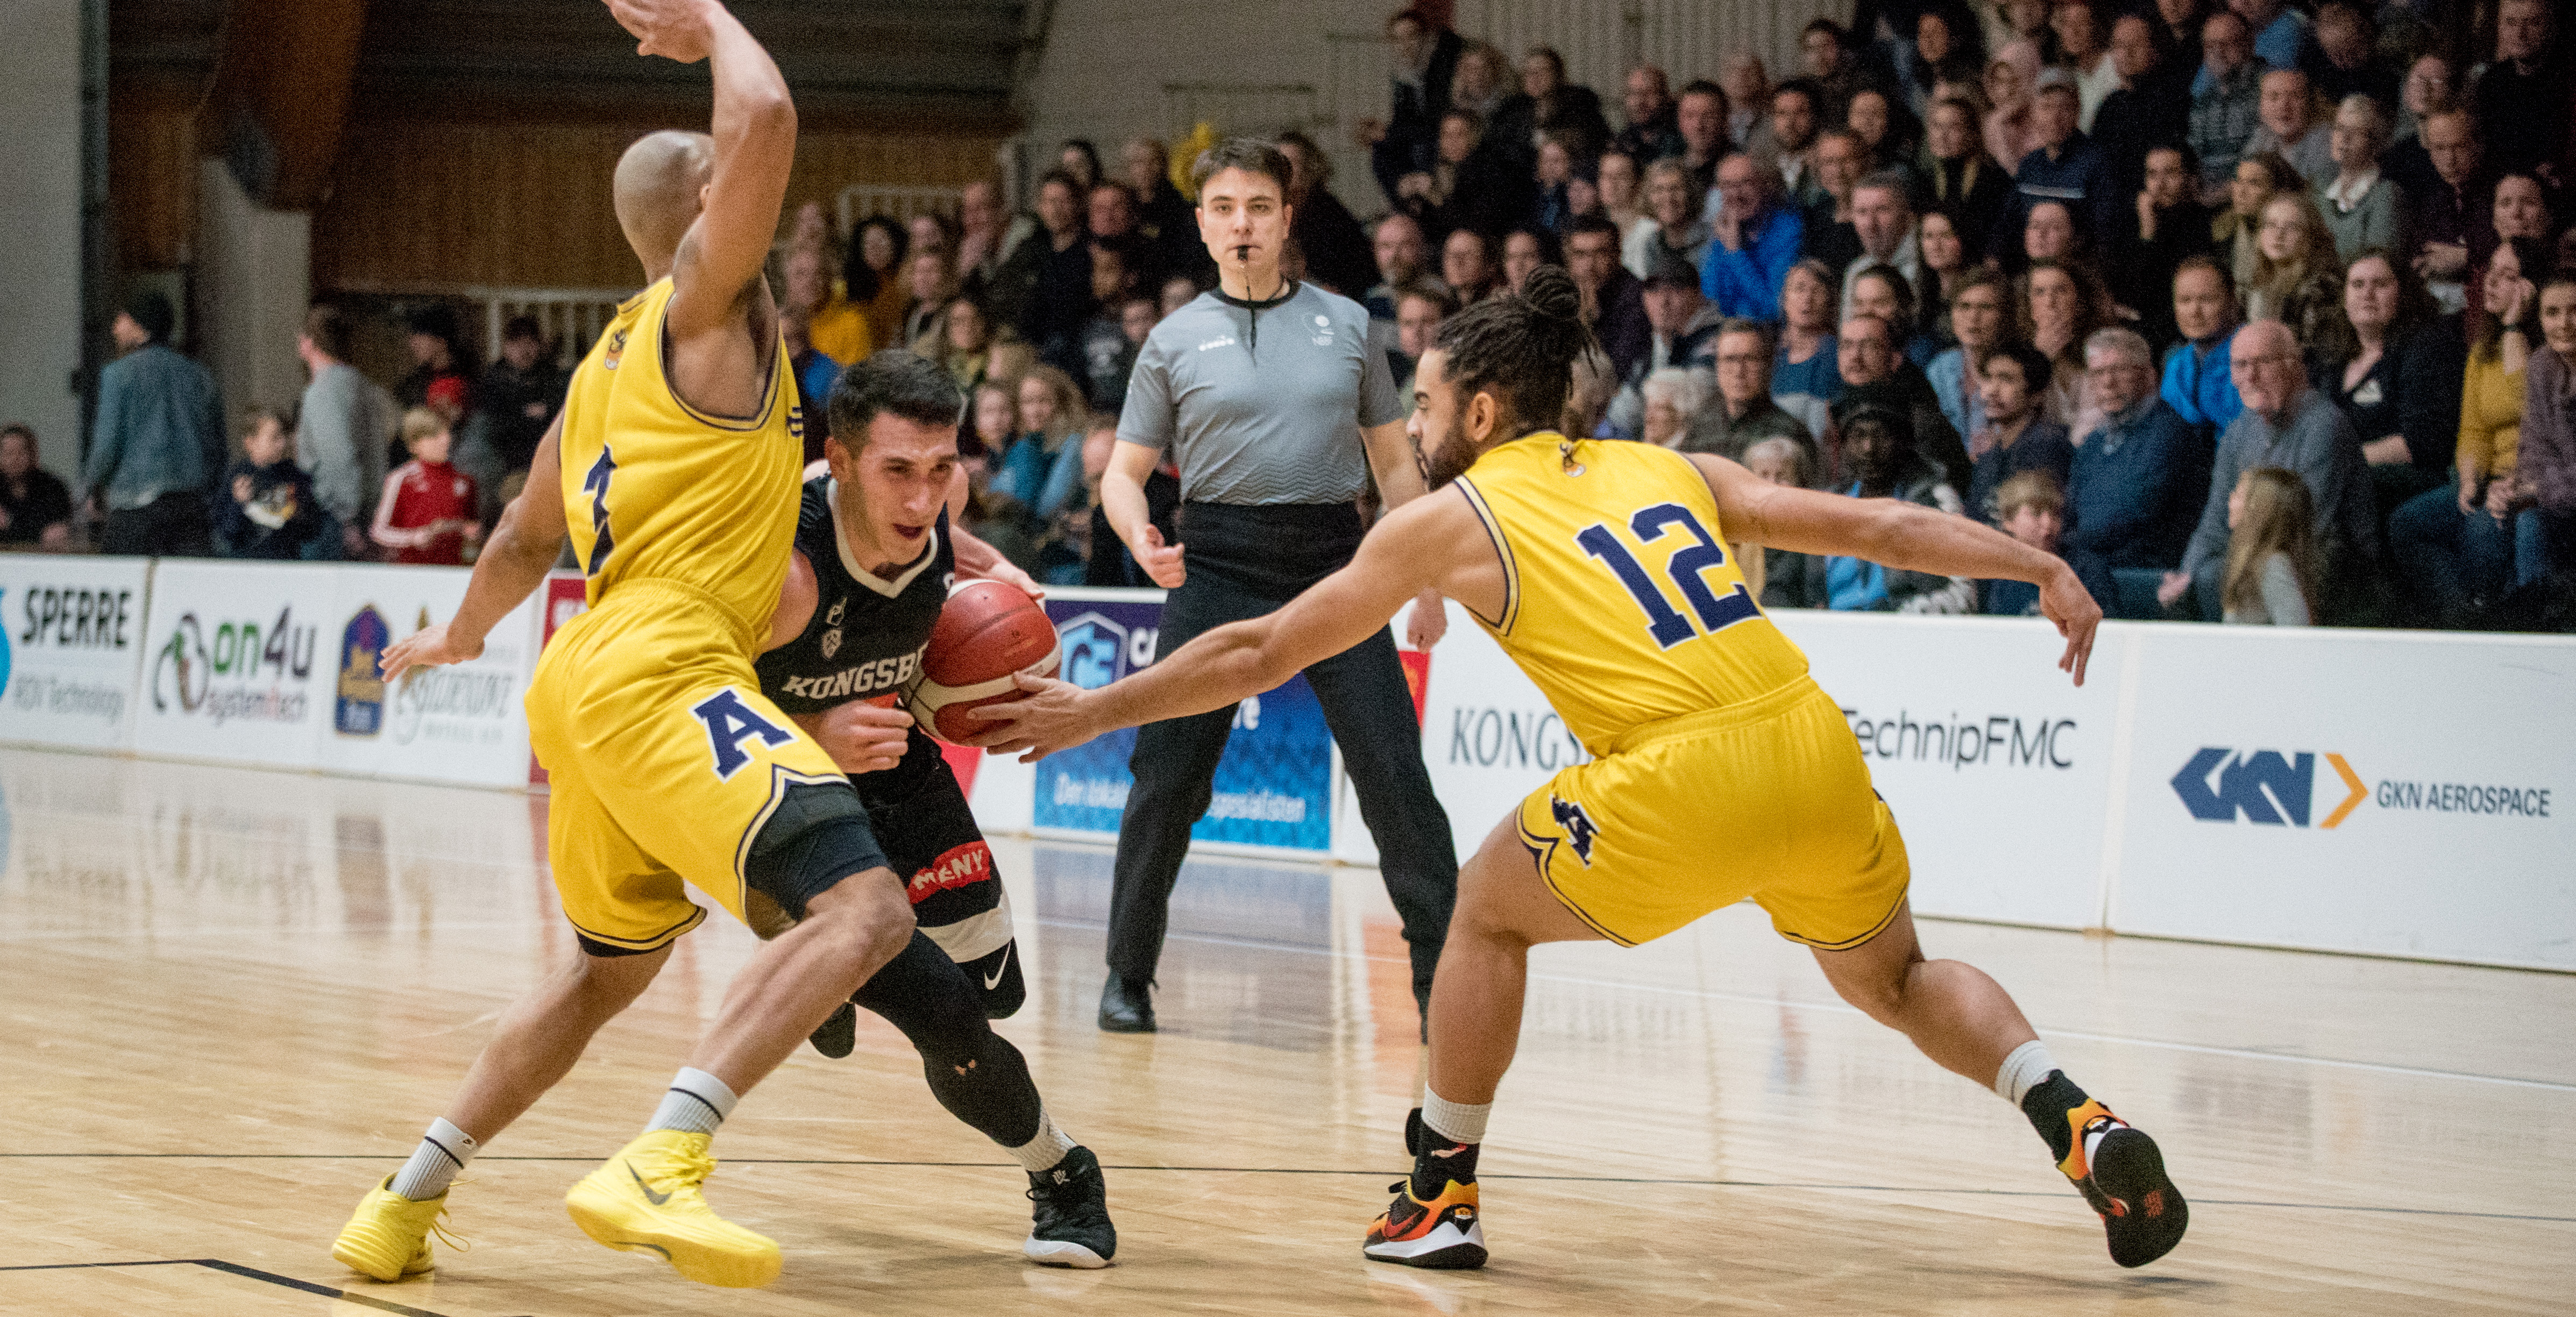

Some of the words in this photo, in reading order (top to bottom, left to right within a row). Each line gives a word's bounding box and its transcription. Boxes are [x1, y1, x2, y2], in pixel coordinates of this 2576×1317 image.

[1572, 501, 1768, 652] 12
[22, 587, 131, 647] SPERRE
[214, 604, 317, 679] on4u
[688, 685, 799, 784] A
[2376, 779, 2423, 810] GKN
[2426, 783, 2552, 818] AEROSPACE
[914, 849, 983, 891] MENY
